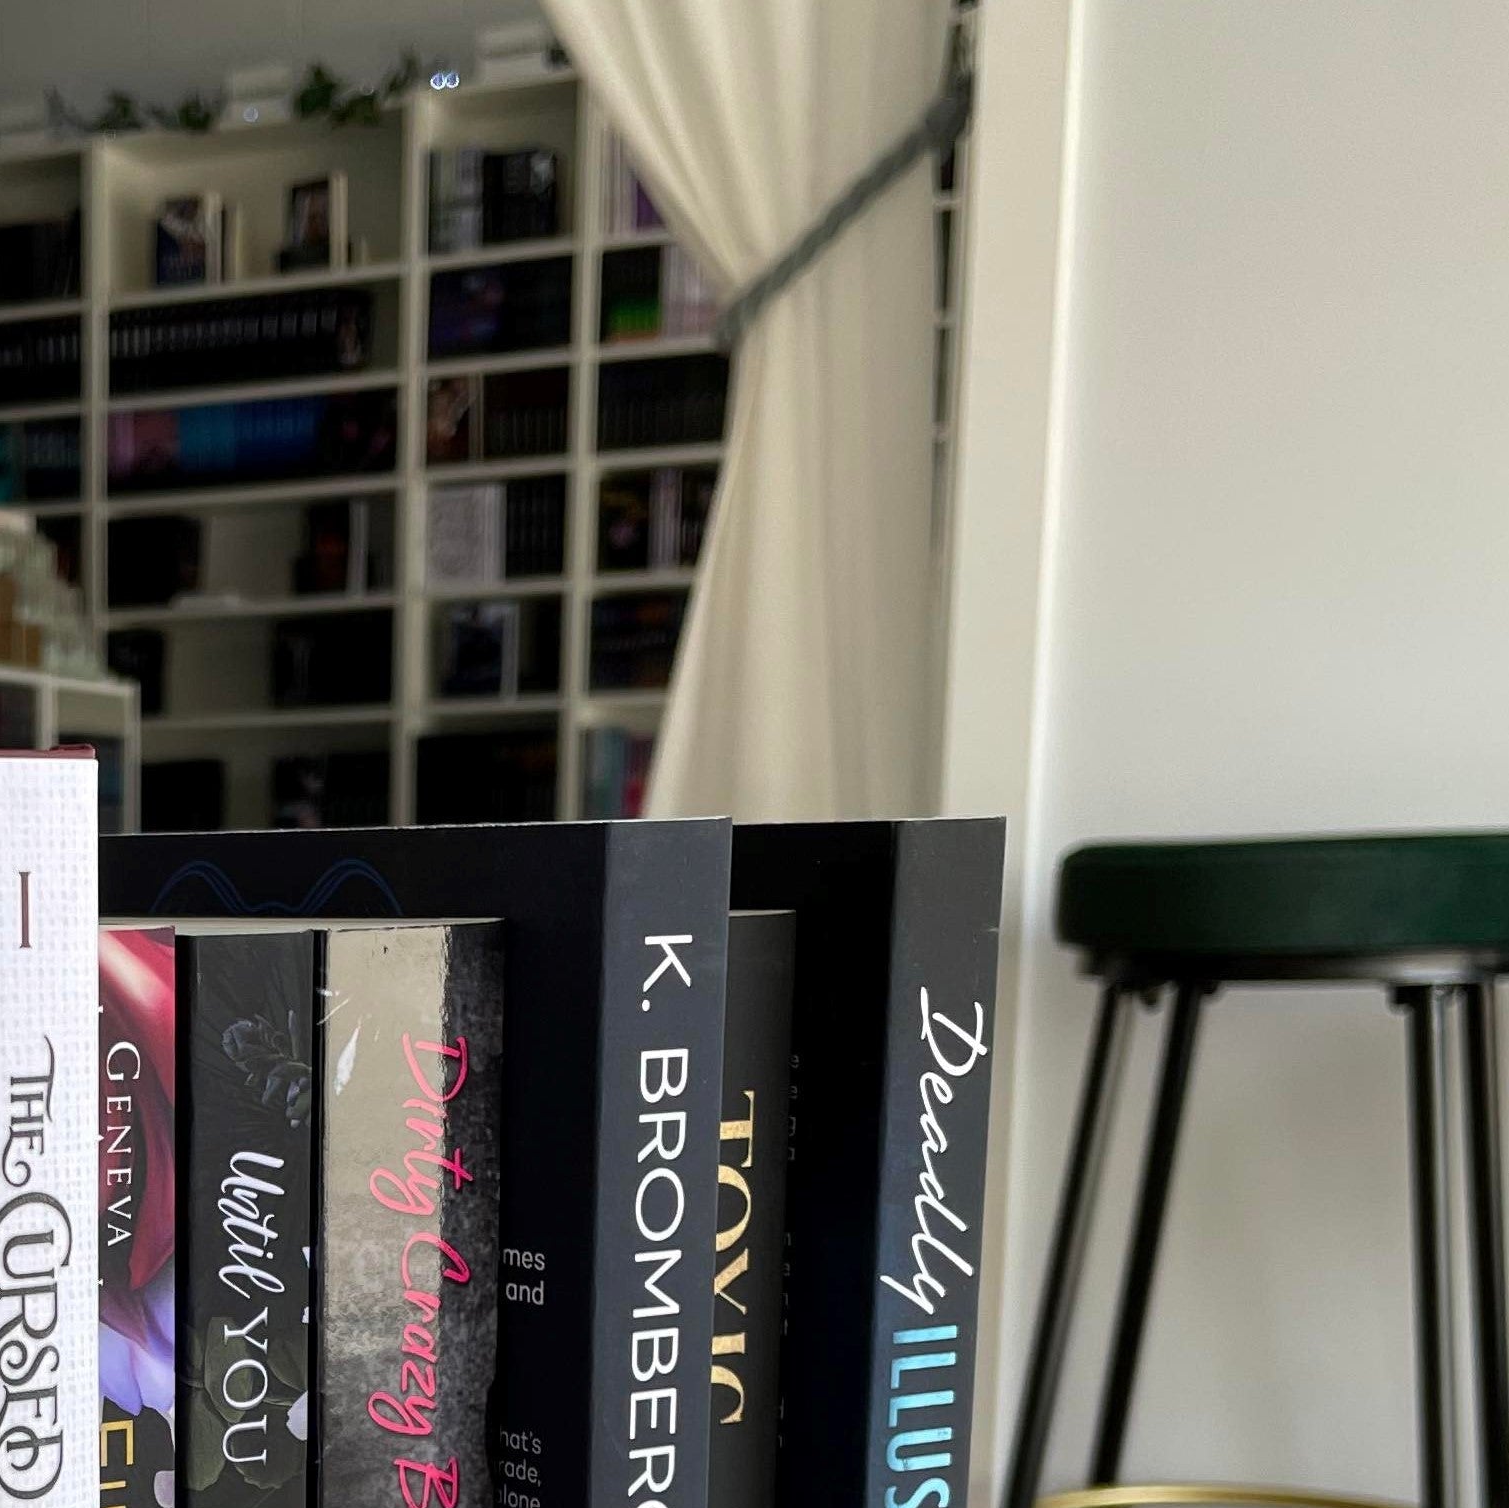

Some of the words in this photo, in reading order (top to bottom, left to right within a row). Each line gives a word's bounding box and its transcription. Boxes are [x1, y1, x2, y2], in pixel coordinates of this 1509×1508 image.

[641, 933, 693, 1012] K.
[1, 1034, 55, 1188] THE
[106, 1041, 141, 1247] GENEVA
[369, 1032, 474, 1216] Dirty
[880, 985, 988, 1315] Deadly
[217, 1151, 286, 1300] Until
[222, 1306, 269, 1467] YOU
[366, 1231, 472, 1436] Crazy
